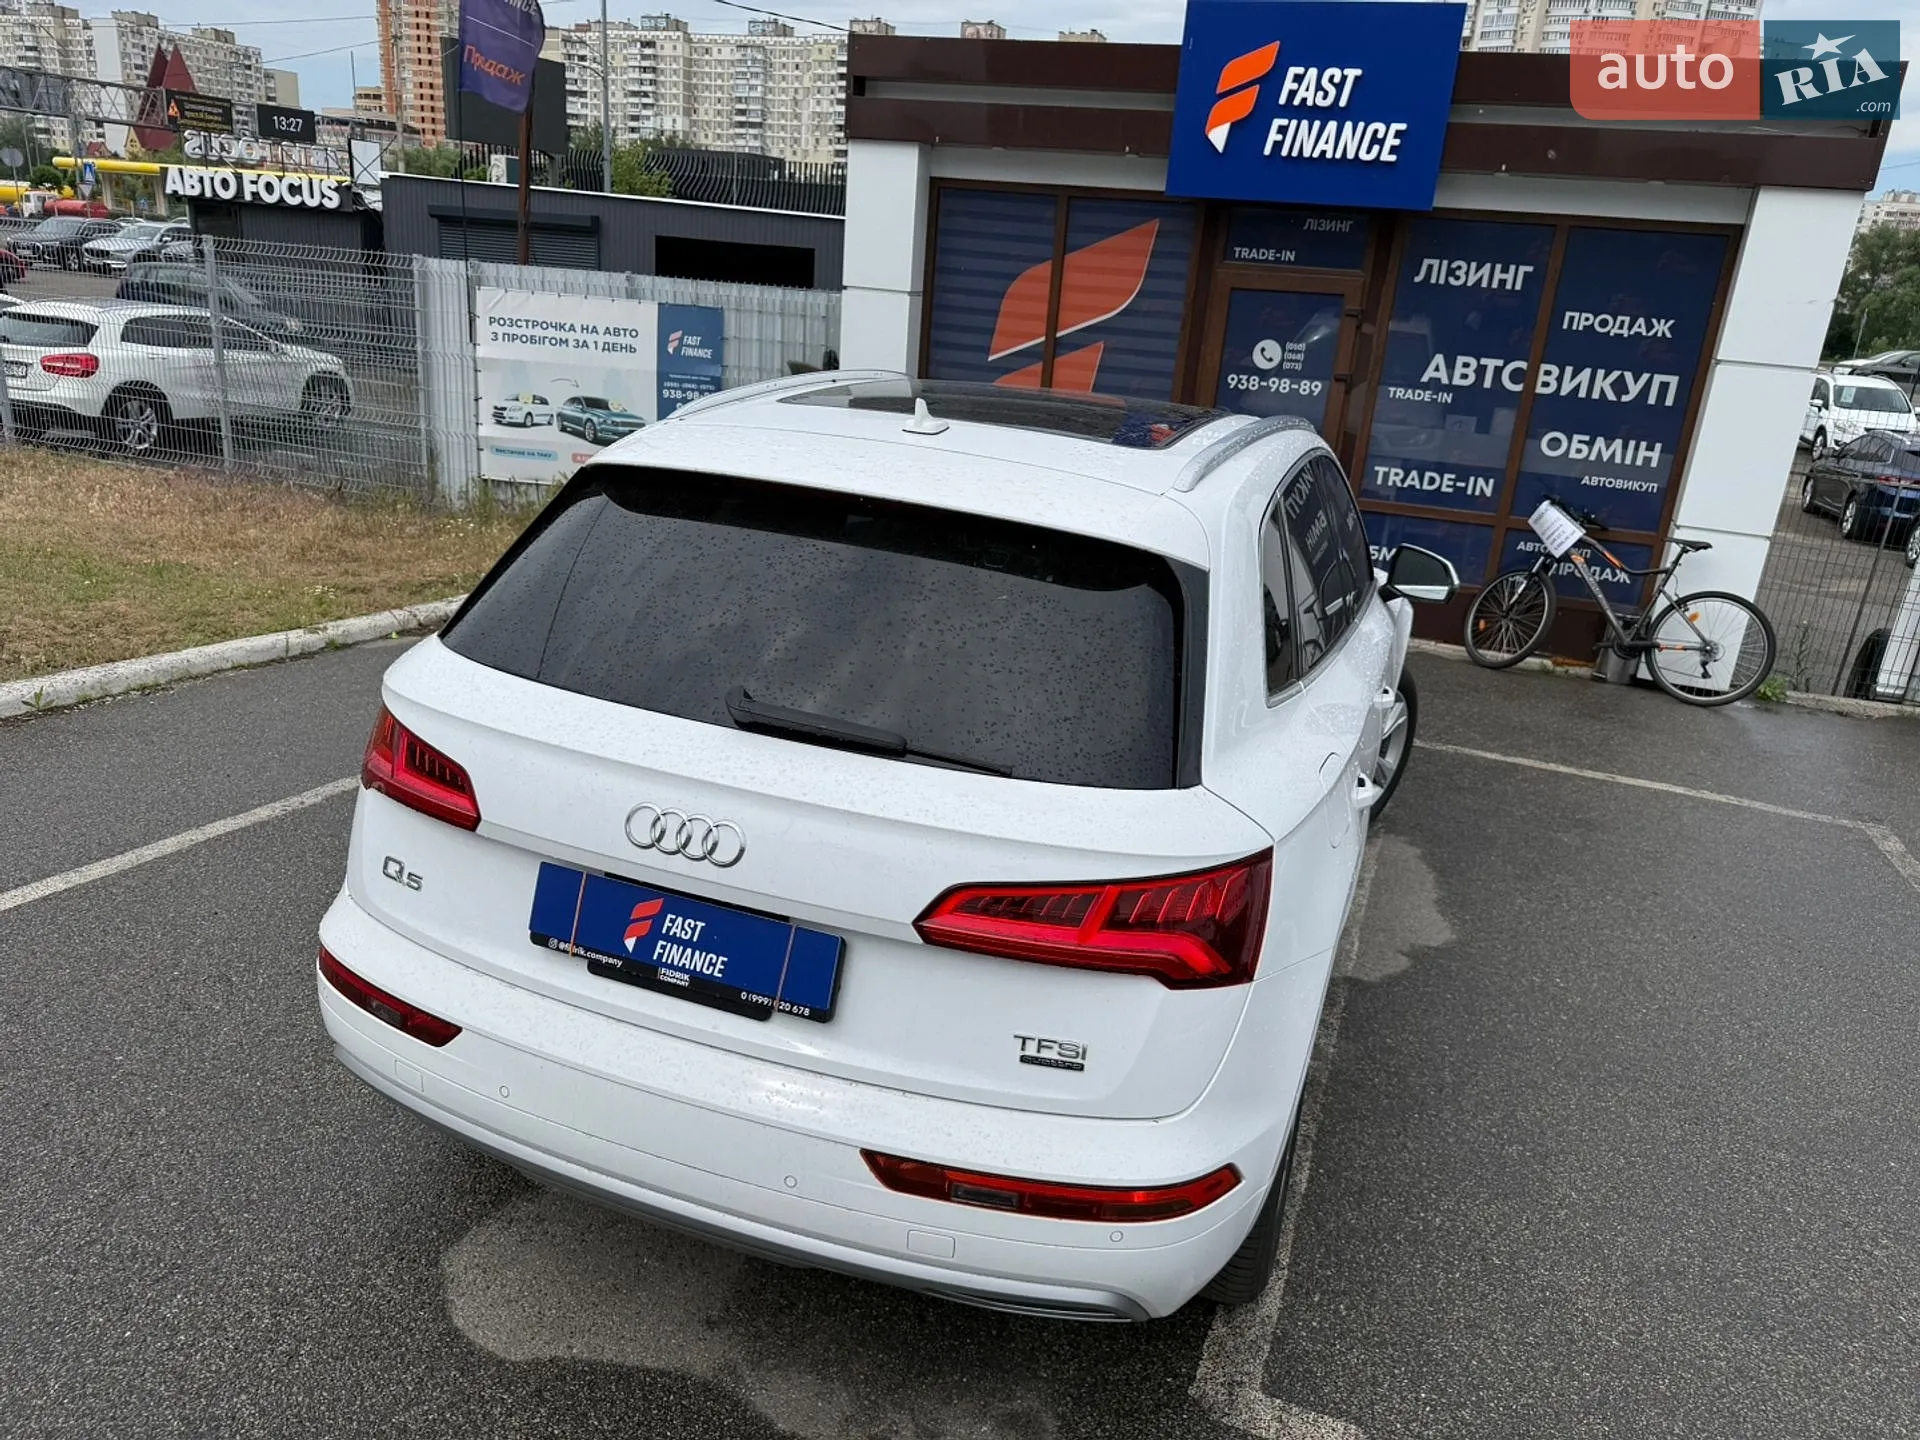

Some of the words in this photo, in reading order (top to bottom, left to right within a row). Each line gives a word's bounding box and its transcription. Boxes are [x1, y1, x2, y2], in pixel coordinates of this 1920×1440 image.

[1278, 66, 1363, 108] FAST
[272, 115, 303, 133] 13:27
[1263, 118, 1408, 162] FINANCE
[165, 167, 238, 200] АВТО
[243, 172, 341, 209] FOCUS
[1303, 218, 1354, 233] ЛІЗИНГ
[1233, 246, 1296, 262] TRADE-IN
[1413, 257, 1535, 291] ЛІЗИНГ
[488, 316, 577, 334] РОЗСТРОЧКА
[580, 323, 599, 336] НА
[603, 326, 639, 339] АВТО
[1562, 310, 1676, 339] ПРОДАЖ
[490, 331, 499, 342] З
[502, 332, 569, 348] ПРОБІГОМ
[572, 338, 590, 350] ЗА
[593, 340, 599, 351] 1
[602, 341, 638, 354] ДЕНЬ
[680, 346, 713, 359] FINANCE
[682, 335, 702, 347] FAST
[1227, 374, 1322, 396] 938-98-89
[1387, 387, 1453, 404] TRADE-IN
[1540, 430, 1663, 468] ОБМІН
[1374, 465, 1495, 498] TRADE-IN
[1580, 474, 1659, 494] АВТОВИКУП
[382, 855, 424, 892] Q5
[661, 913, 706, 942] FAST
[652, 940, 729, 978] FINANCE
[660, 975, 689, 988] COMPANY
[661, 967, 690, 982] FIDRIK
[741, 991, 748, 1000] 0
[748, 993, 772, 1007] (999)
[791, 1005, 810, 1016] 678
[1013, 1034, 1088, 1061] TFSI
